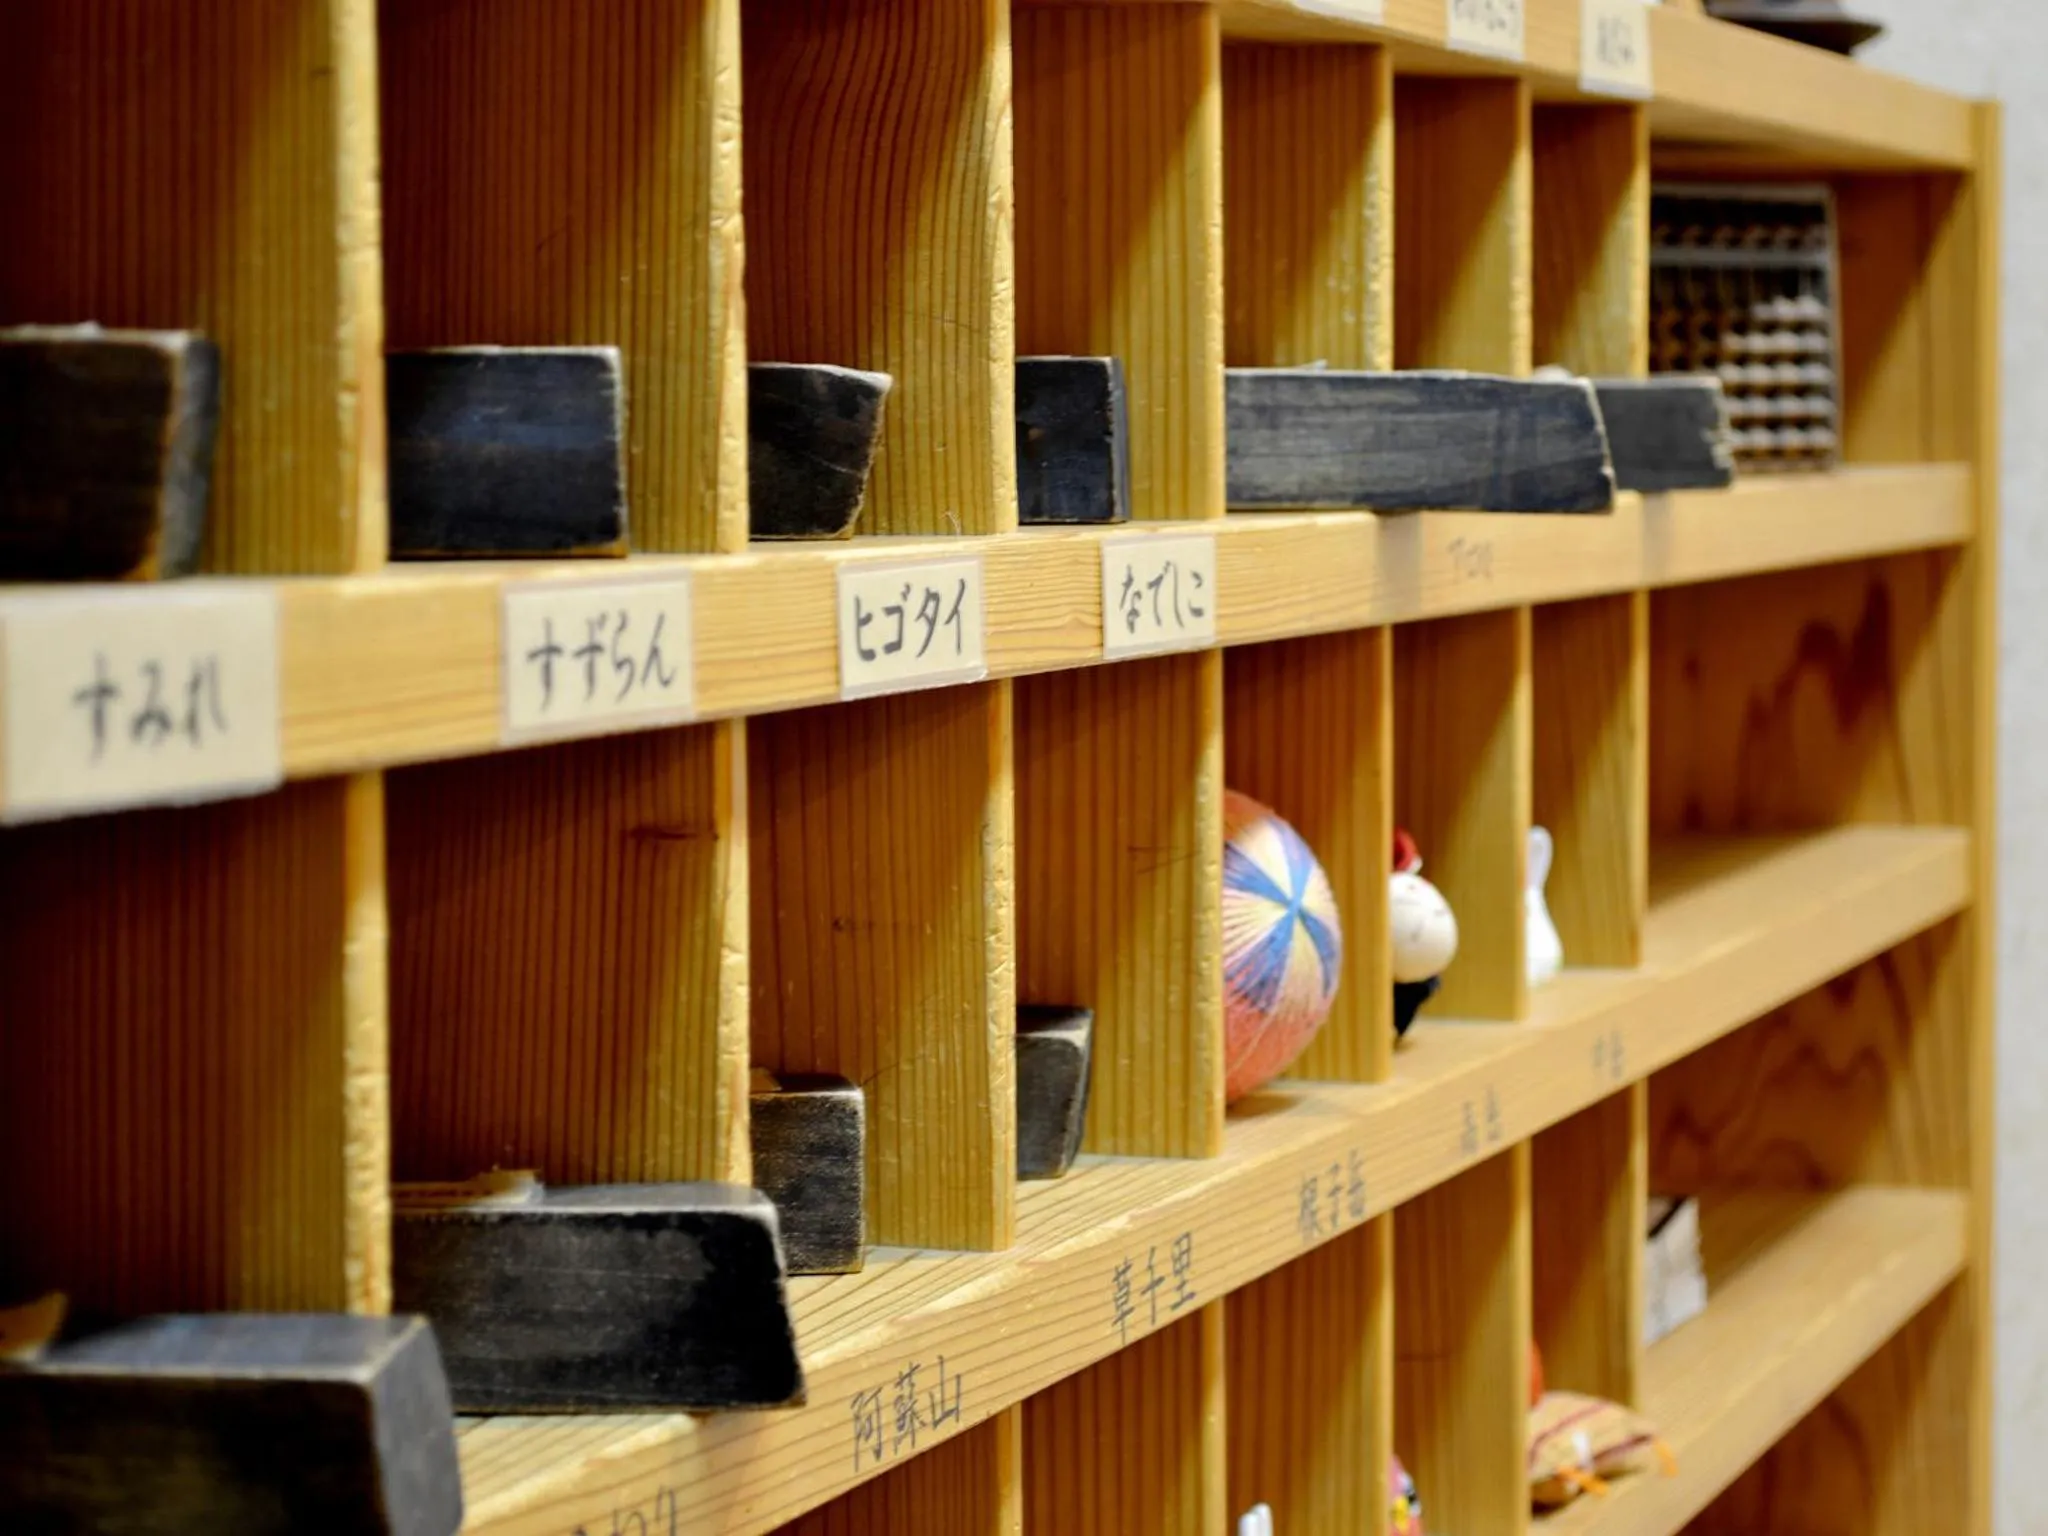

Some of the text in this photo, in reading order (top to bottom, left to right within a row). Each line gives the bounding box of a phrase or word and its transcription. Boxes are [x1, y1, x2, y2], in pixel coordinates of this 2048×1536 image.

[852, 577, 967, 662] ヒゴタイ
[1119, 560, 1206, 635] なでしこ
[73, 650, 229, 768] すみれ
[525, 609, 677, 712] すずらん
[1111, 1230, 1197, 1347] 草千里
[850, 1354, 963, 1473] 阿蘇山
